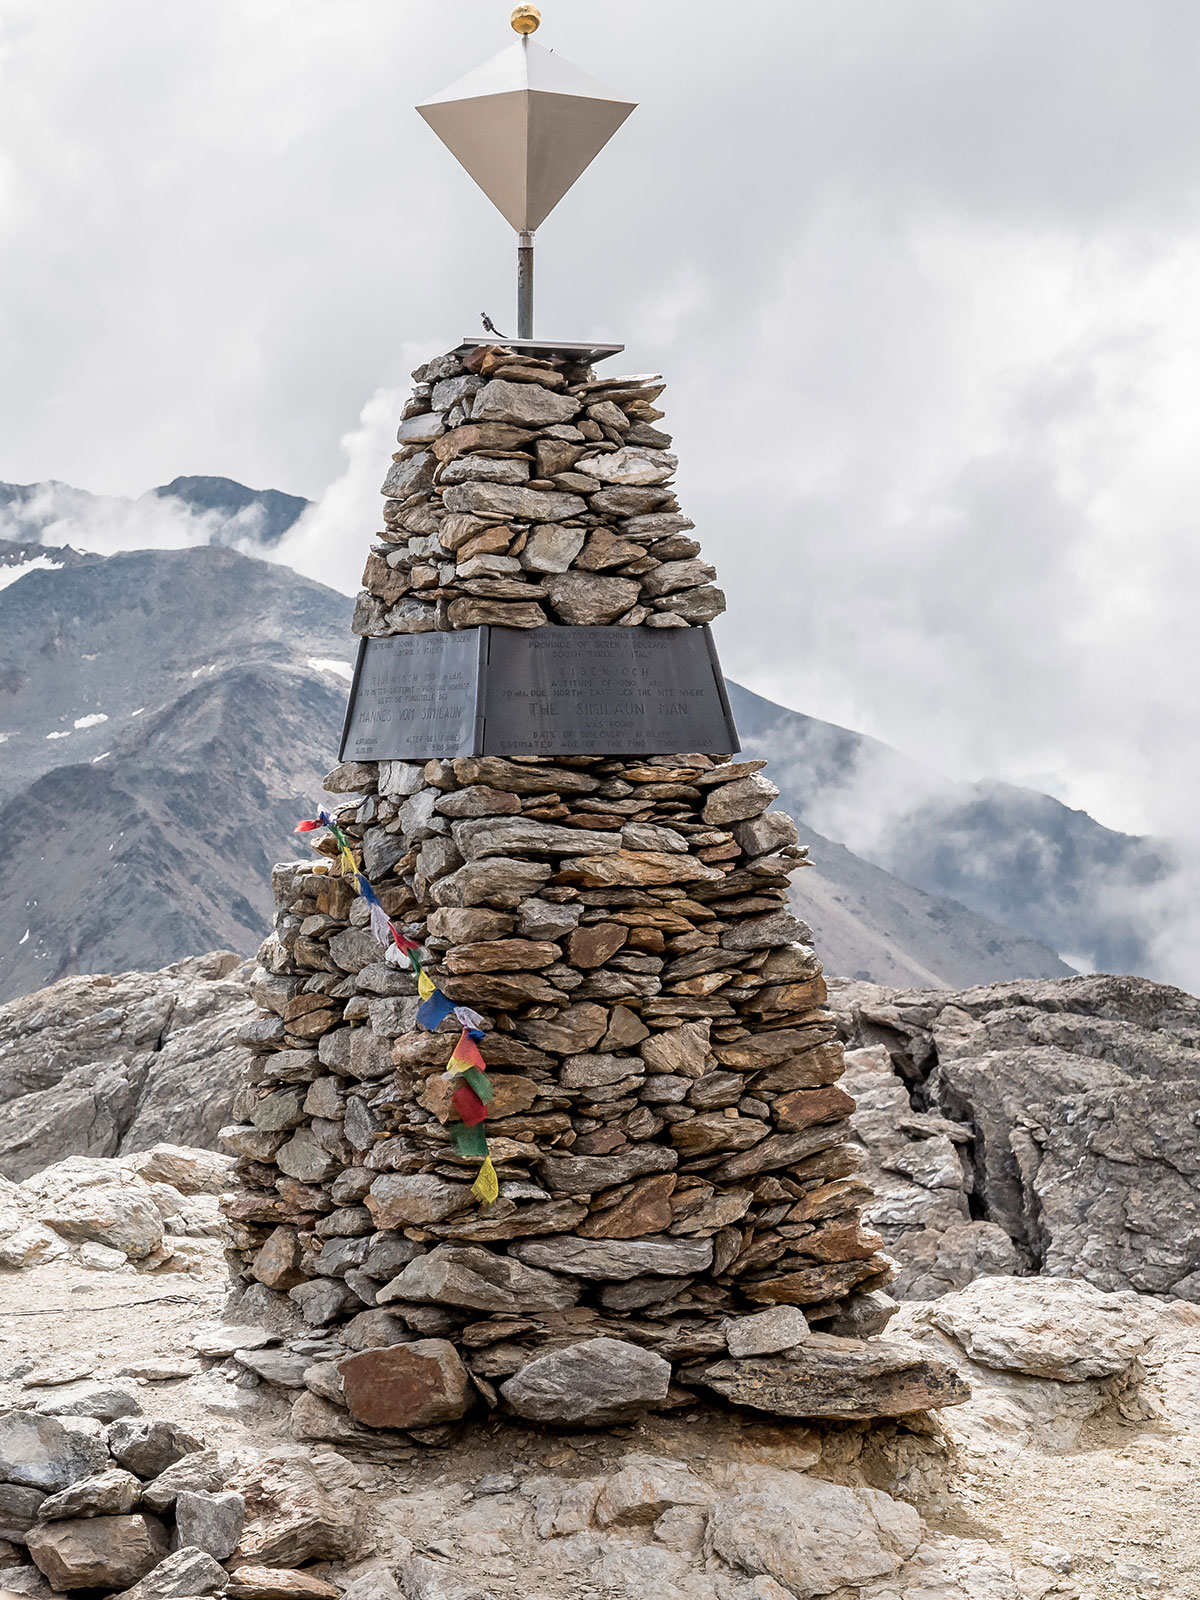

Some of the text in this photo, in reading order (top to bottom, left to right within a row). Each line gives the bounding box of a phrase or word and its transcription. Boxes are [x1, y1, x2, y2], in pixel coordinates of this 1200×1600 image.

[529, 640, 570, 649] PROVINCE
[578, 640, 588, 648] OF
[530, 689, 547, 697] DUE
[637, 688, 652, 697] THE
[358, 705, 462, 723] MANNES VOM SIMILAUN
[528, 702, 689, 717] THE SIMILAUN MAN
[532, 730, 557, 740] DATE
[563, 730, 575, 739] OF
[500, 740, 553, 750] ESTIMATED
[560, 740, 579, 748] AGE
